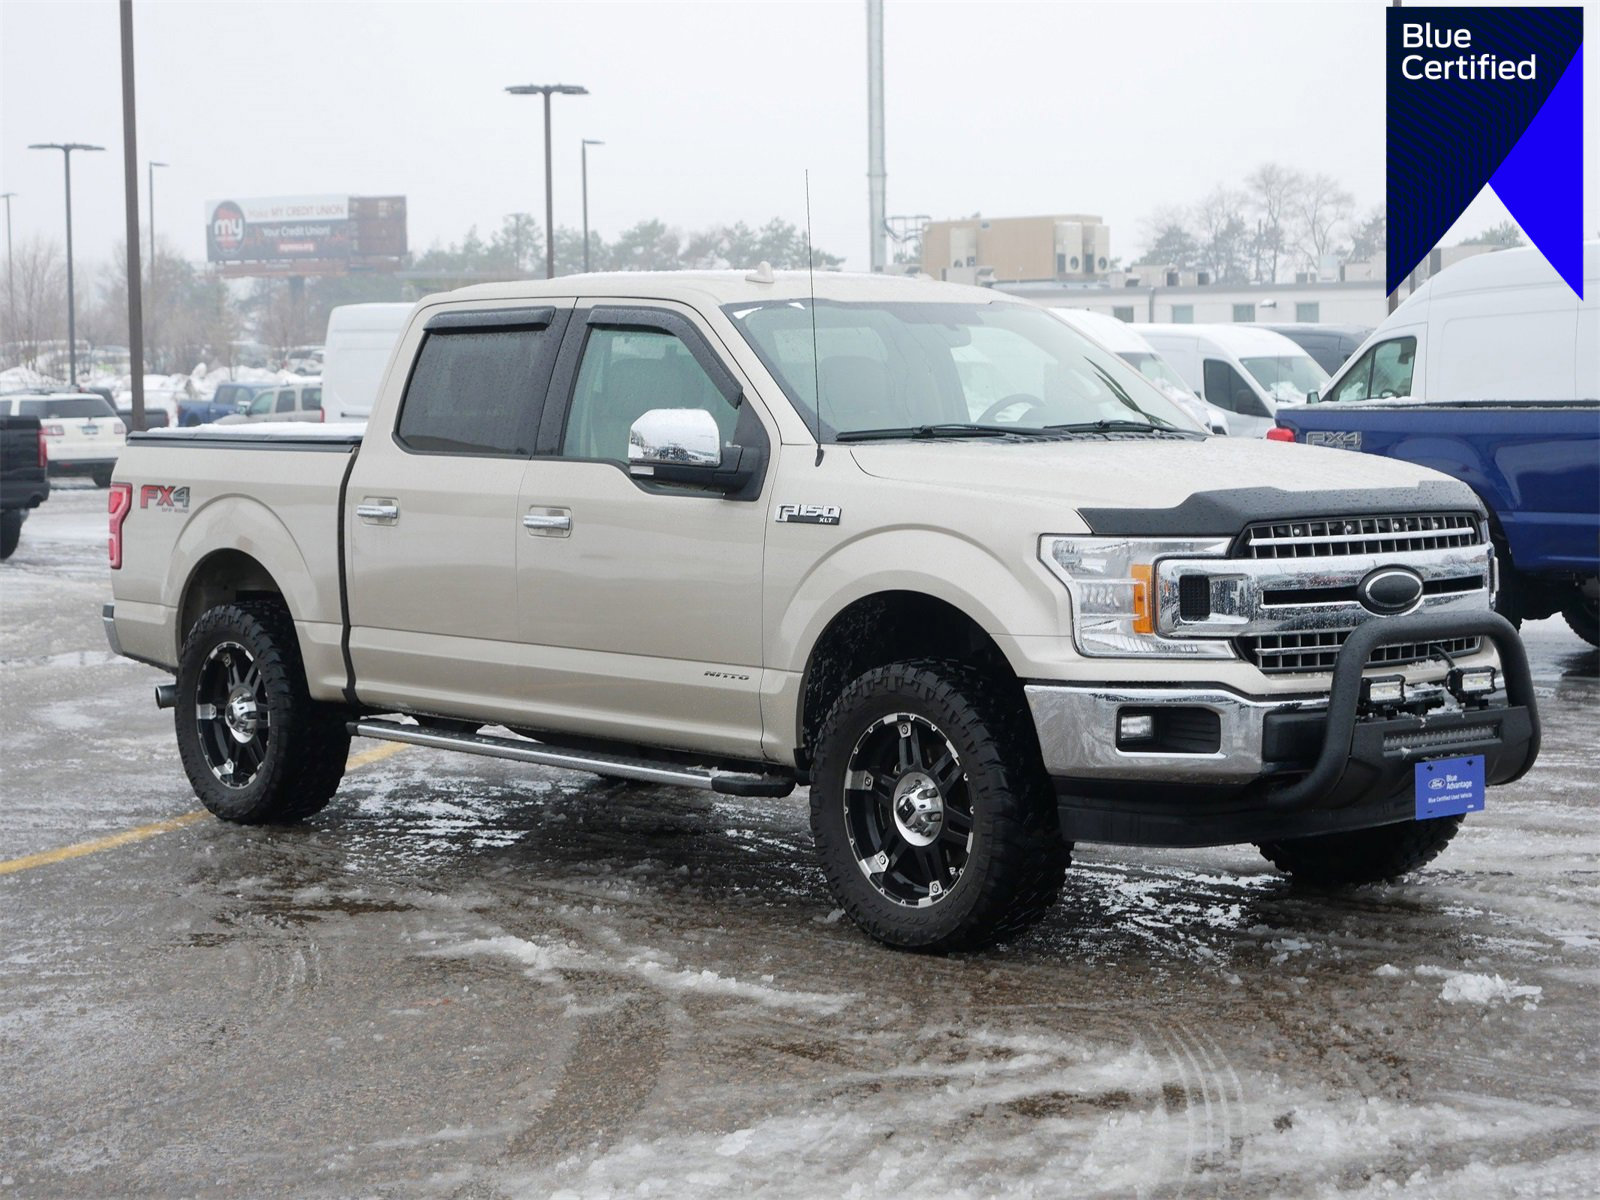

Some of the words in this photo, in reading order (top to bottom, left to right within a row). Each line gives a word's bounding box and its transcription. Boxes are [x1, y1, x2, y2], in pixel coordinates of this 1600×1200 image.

[287, 206, 314, 216] CREDIT
[316, 205, 344, 215] UNION
[214, 218, 243, 241] my
[263, 227, 281, 238] Your
[281, 226, 304, 237] Credit
[1306, 431, 1362, 447] FX4
[140, 484, 190, 509] FX4
[704, 670, 750, 681] NITTO
[1446, 780, 1472, 790] Advantage
